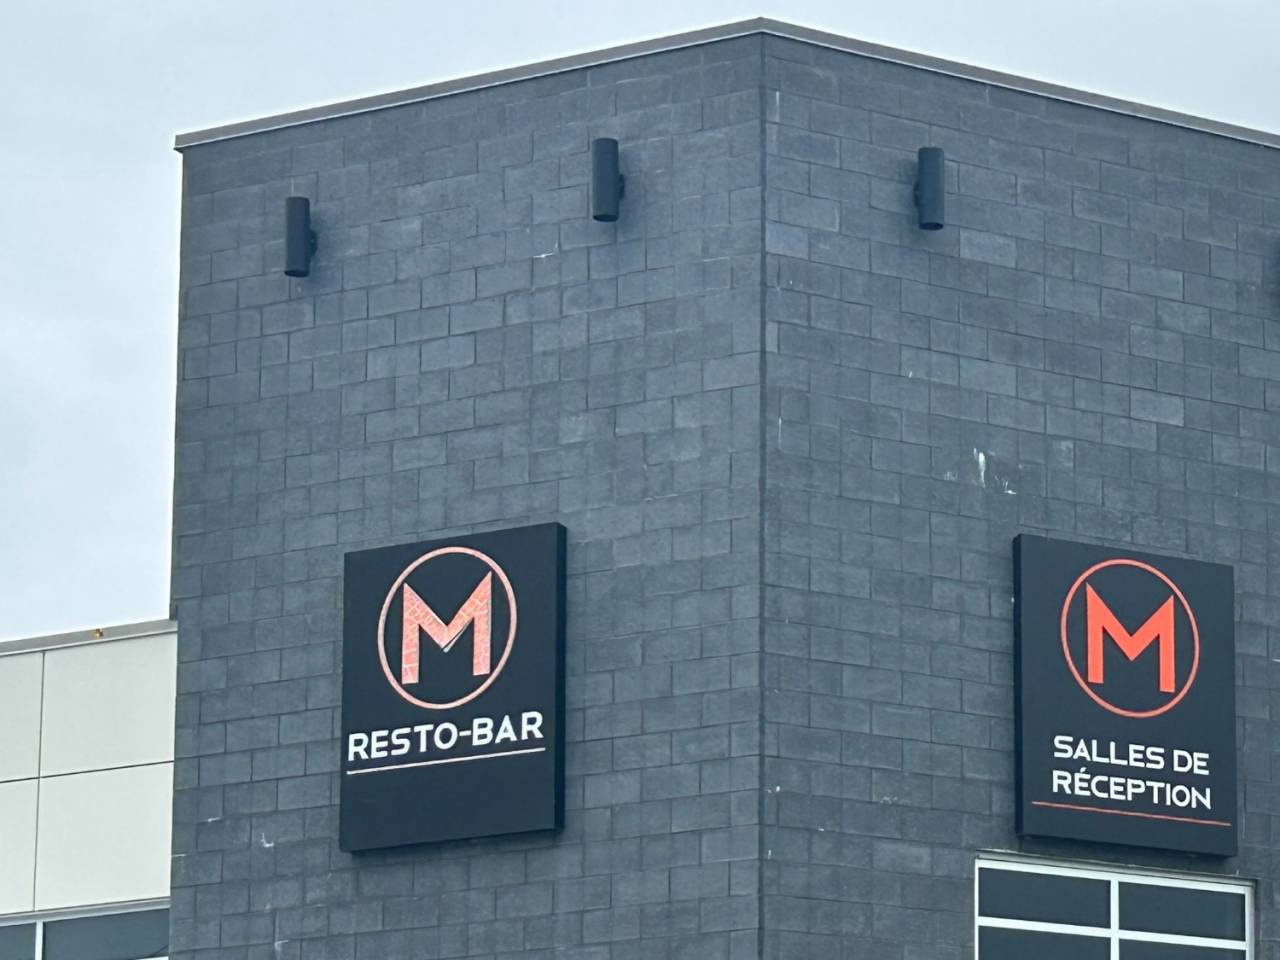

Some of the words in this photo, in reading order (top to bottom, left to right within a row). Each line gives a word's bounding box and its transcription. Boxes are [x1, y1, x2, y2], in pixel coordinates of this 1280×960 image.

[402, 570, 493, 685] M
[1085, 583, 1176, 693] M
[347, 711, 545, 762] RESTO-BAR
[1053, 735, 1165, 770] SALLES
[1173, 750, 1211, 776] DE
[1052, 767, 1212, 810] RÉCEPTION
